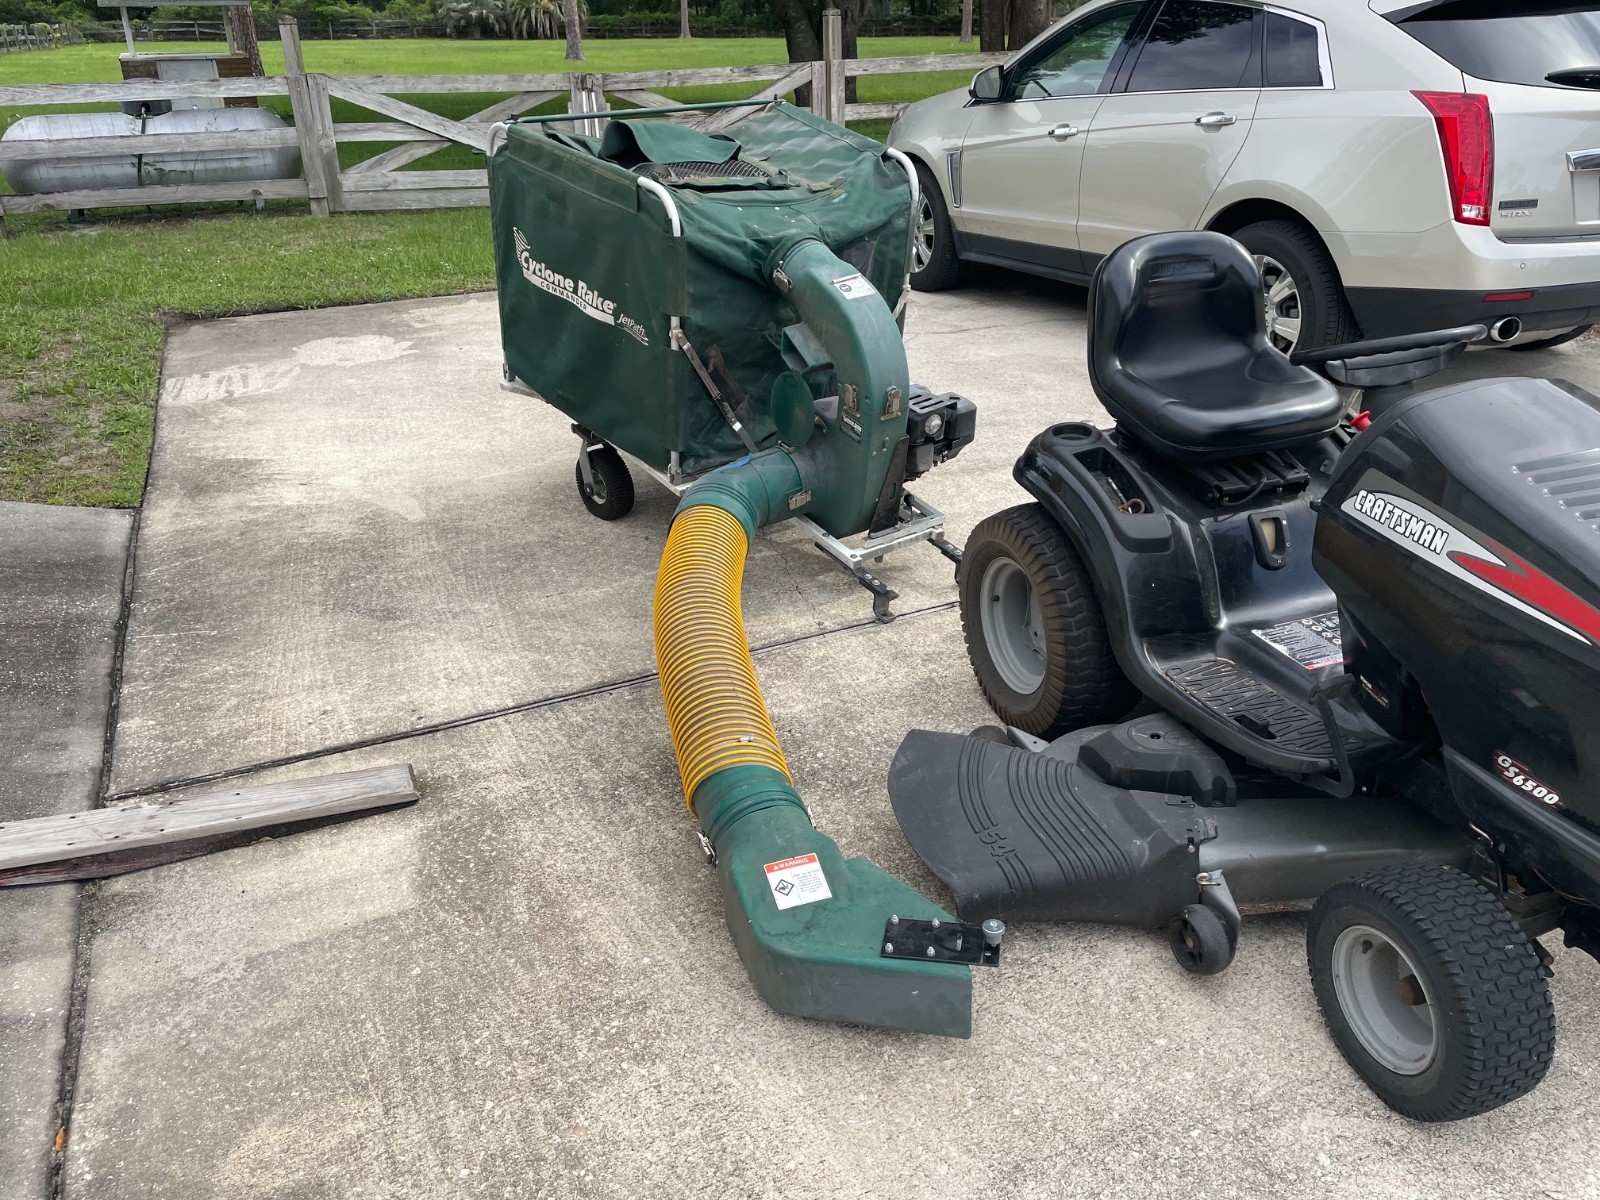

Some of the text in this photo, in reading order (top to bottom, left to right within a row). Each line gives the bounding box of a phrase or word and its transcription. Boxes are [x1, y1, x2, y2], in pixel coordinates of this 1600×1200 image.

[521, 251, 614, 314] Cyclone Rake
[540, 281, 587, 311] COMMANDER
[617, 313, 646, 336] JetPath
[1354, 489, 1449, 555] CRAFTSMAN
[1497, 755, 1560, 805] GS6500
[779, 857, 809, 869] WARNING
